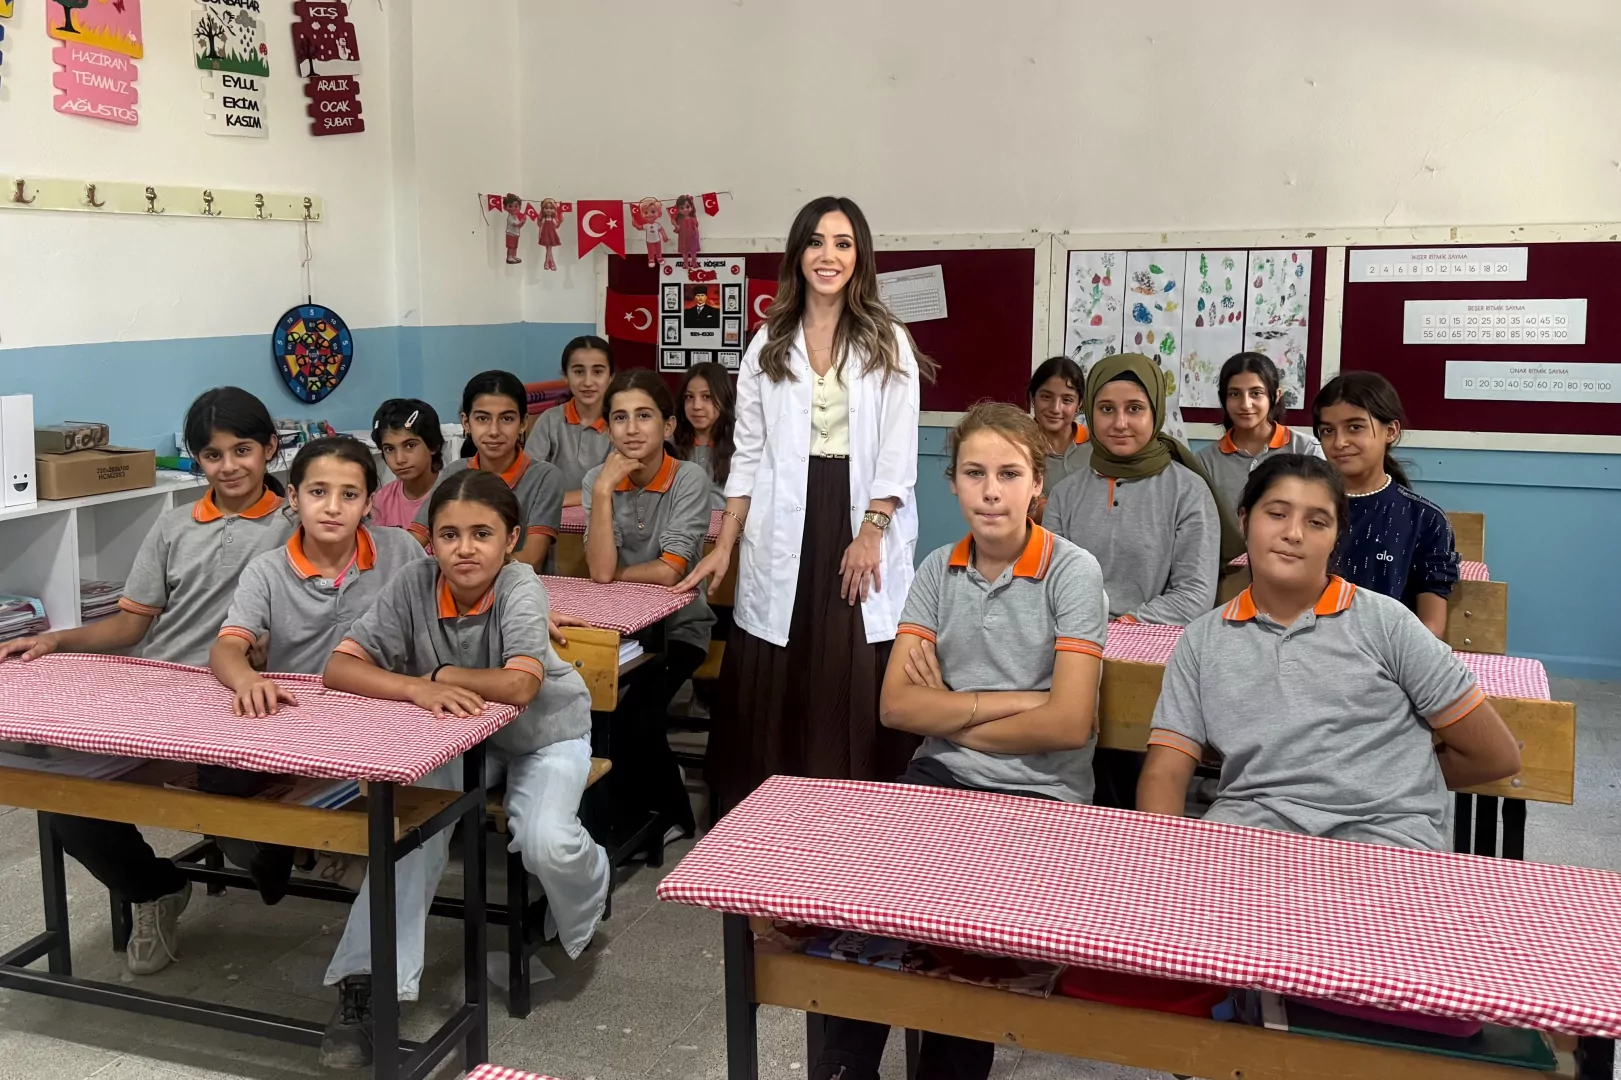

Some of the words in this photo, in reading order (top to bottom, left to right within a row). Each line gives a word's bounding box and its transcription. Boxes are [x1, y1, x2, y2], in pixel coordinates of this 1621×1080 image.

[310, 7, 338, 19] KIŞ
[72, 70, 130, 94] TEMMUZ
[318, 80, 350, 91] ARALIK
[61, 98, 138, 121] AĞUSTOS
[223, 96, 260, 112] EKİM
[320, 101, 351, 112] OCAK
[226, 114, 262, 129] KASIM
[324, 117, 354, 128] ŞUBAT
[1376, 550, 1394, 562] alo
